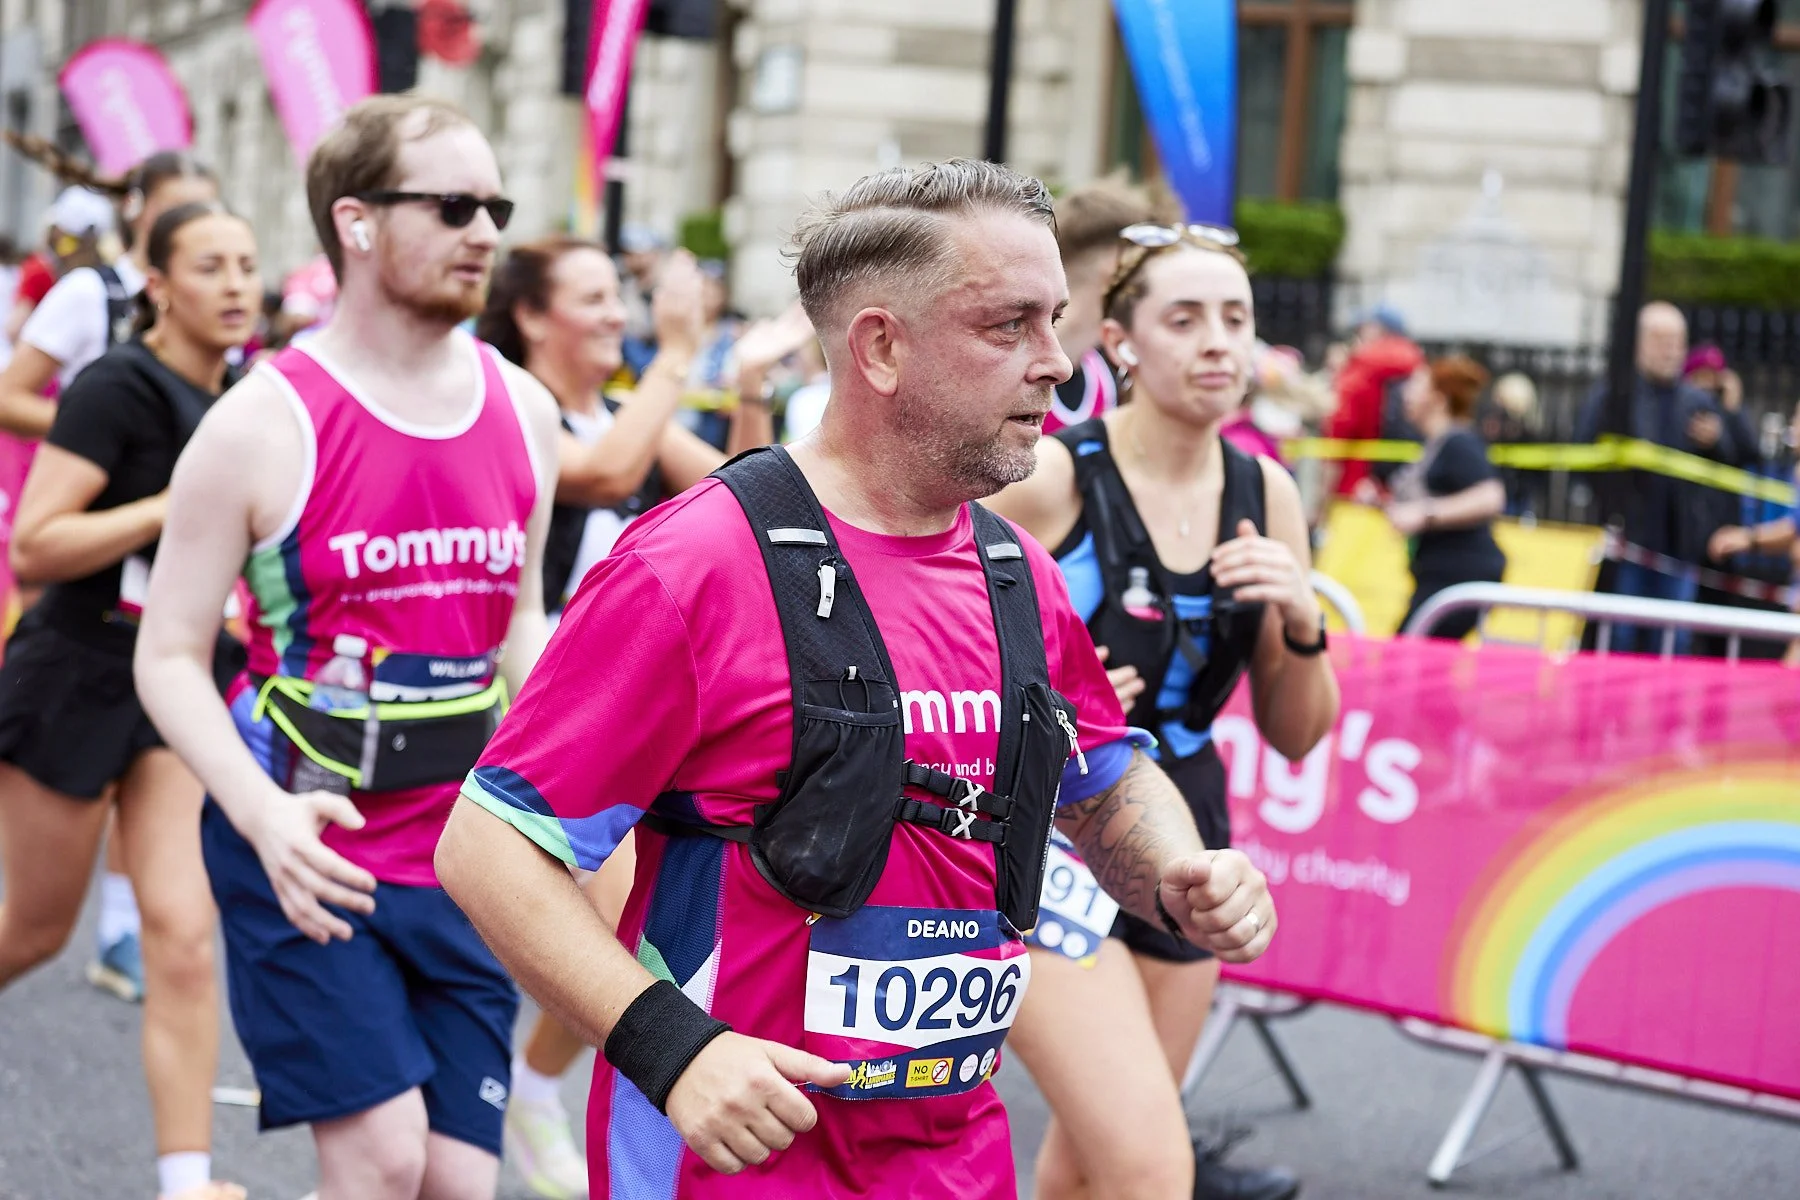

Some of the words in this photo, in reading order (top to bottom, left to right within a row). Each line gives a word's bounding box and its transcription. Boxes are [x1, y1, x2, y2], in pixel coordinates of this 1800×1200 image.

[986, 758, 996, 776] b
[1291, 847, 1411, 906] charity
[907, 919, 979, 939] DEANO
[829, 963, 1021, 1031] 10296
[913, 1065, 929, 1075] NO
